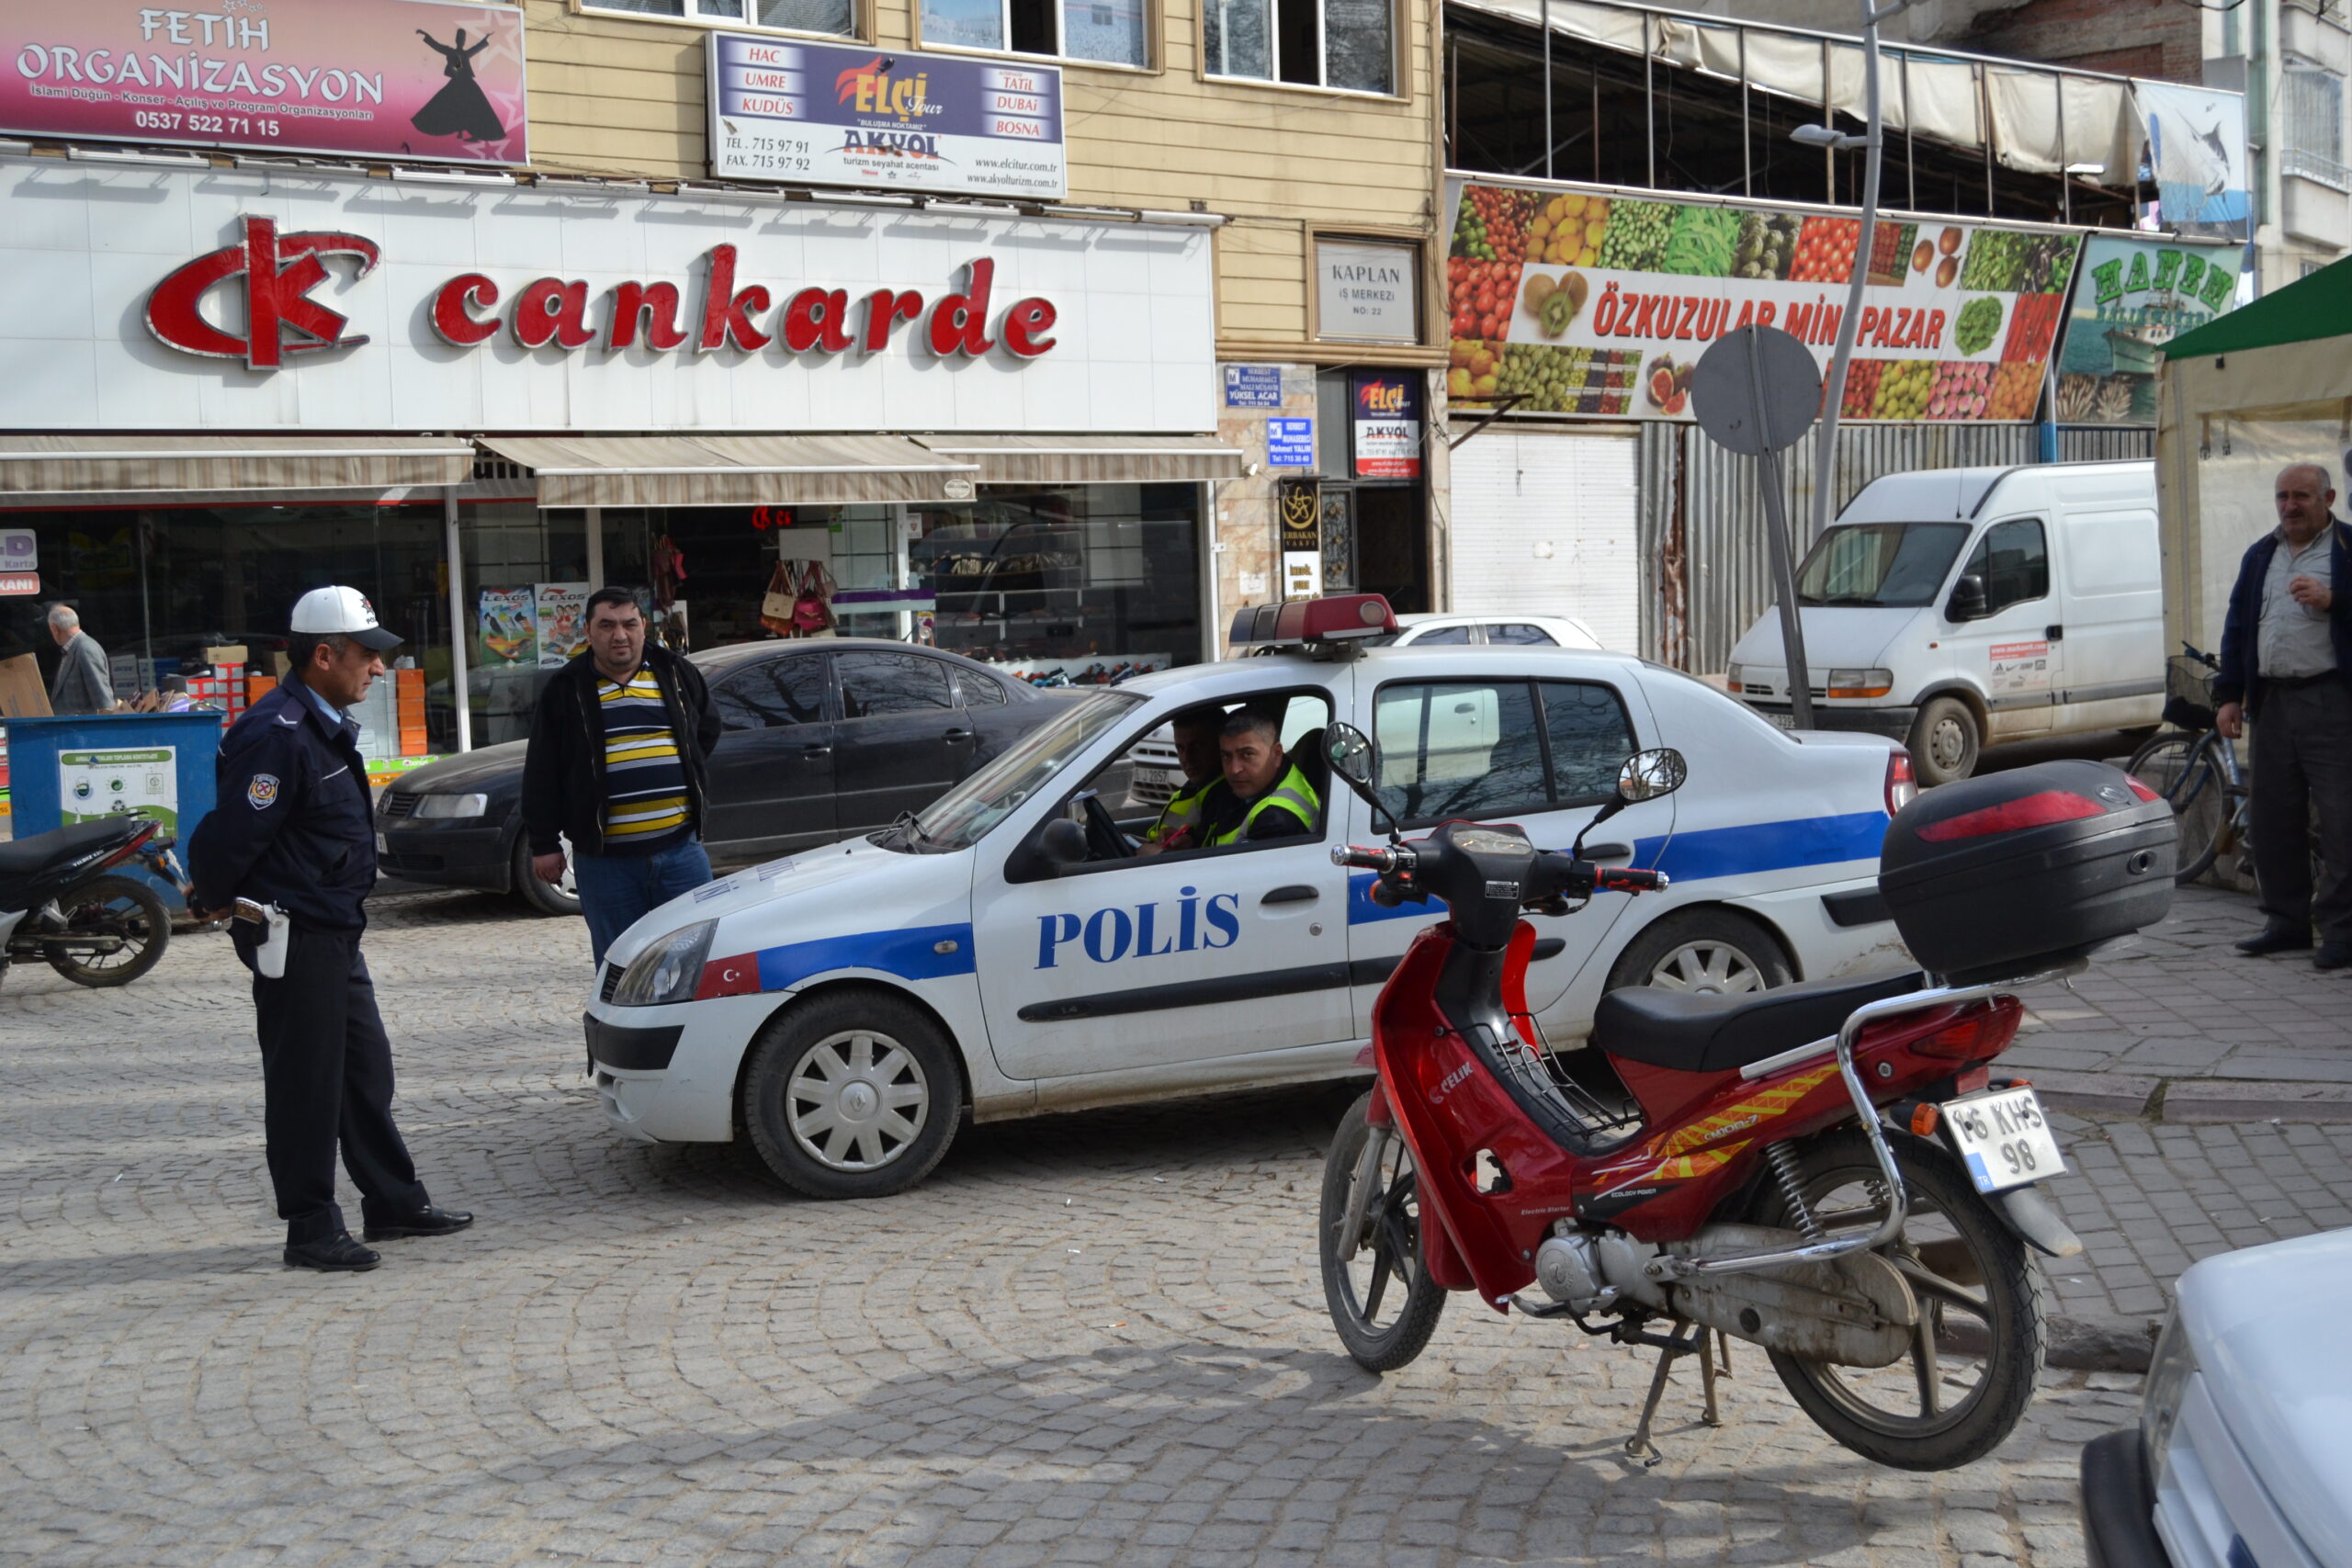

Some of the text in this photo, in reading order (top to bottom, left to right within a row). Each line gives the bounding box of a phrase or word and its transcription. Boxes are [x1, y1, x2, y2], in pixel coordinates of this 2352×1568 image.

[749, 48, 781, 62] HAC
[17, 43, 383, 105] ORGANİZASYON
[745, 73, 786, 88] UMRE
[31, 85, 68, 97] İslami
[72, 88, 110, 101] Düğün
[122, 92, 165, 105] Konser
[175, 96, 208, 108] Açılış
[229, 100, 277, 113] Program
[280, 105, 373, 119] Organizasyonları
[742, 97, 793, 115] KUDÜS
[136, 111, 279, 136] 0537 522 71 15
[997, 120, 1040, 136] BOSNA
[752, 137, 775, 152] 715
[777, 139, 793, 152] 97
[796, 141, 809, 153] 91
[843, 130, 939, 159] AKYOL
[752, 154, 775, 168] 715
[777, 156, 792, 169] 97
[796, 158, 810, 171] 92
[843, 157, 870, 166] turizm
[872, 160, 903, 171] seyahat
[975, 158, 1057, 173] www.elcitur.com.tr
[967, 174, 1057, 188] www.akyolturizm.com.tr
[1332, 265, 1400, 283] KAPLAN
[428, 243, 1057, 361] cankarde
[1856, 305, 1946, 349] PAZAR
[1229, 389, 1278, 400] YÜKSEL ACAR
[1366, 426, 1409, 439] AKYOL
[538, 593, 586, 602] LEXOS
[1034, 886, 1240, 970] POLİS
[1952, 1097, 2041, 1143] 16 KHS
[2000, 1138, 2036, 1174] 98
[1977, 1176, 1991, 1186] TR
